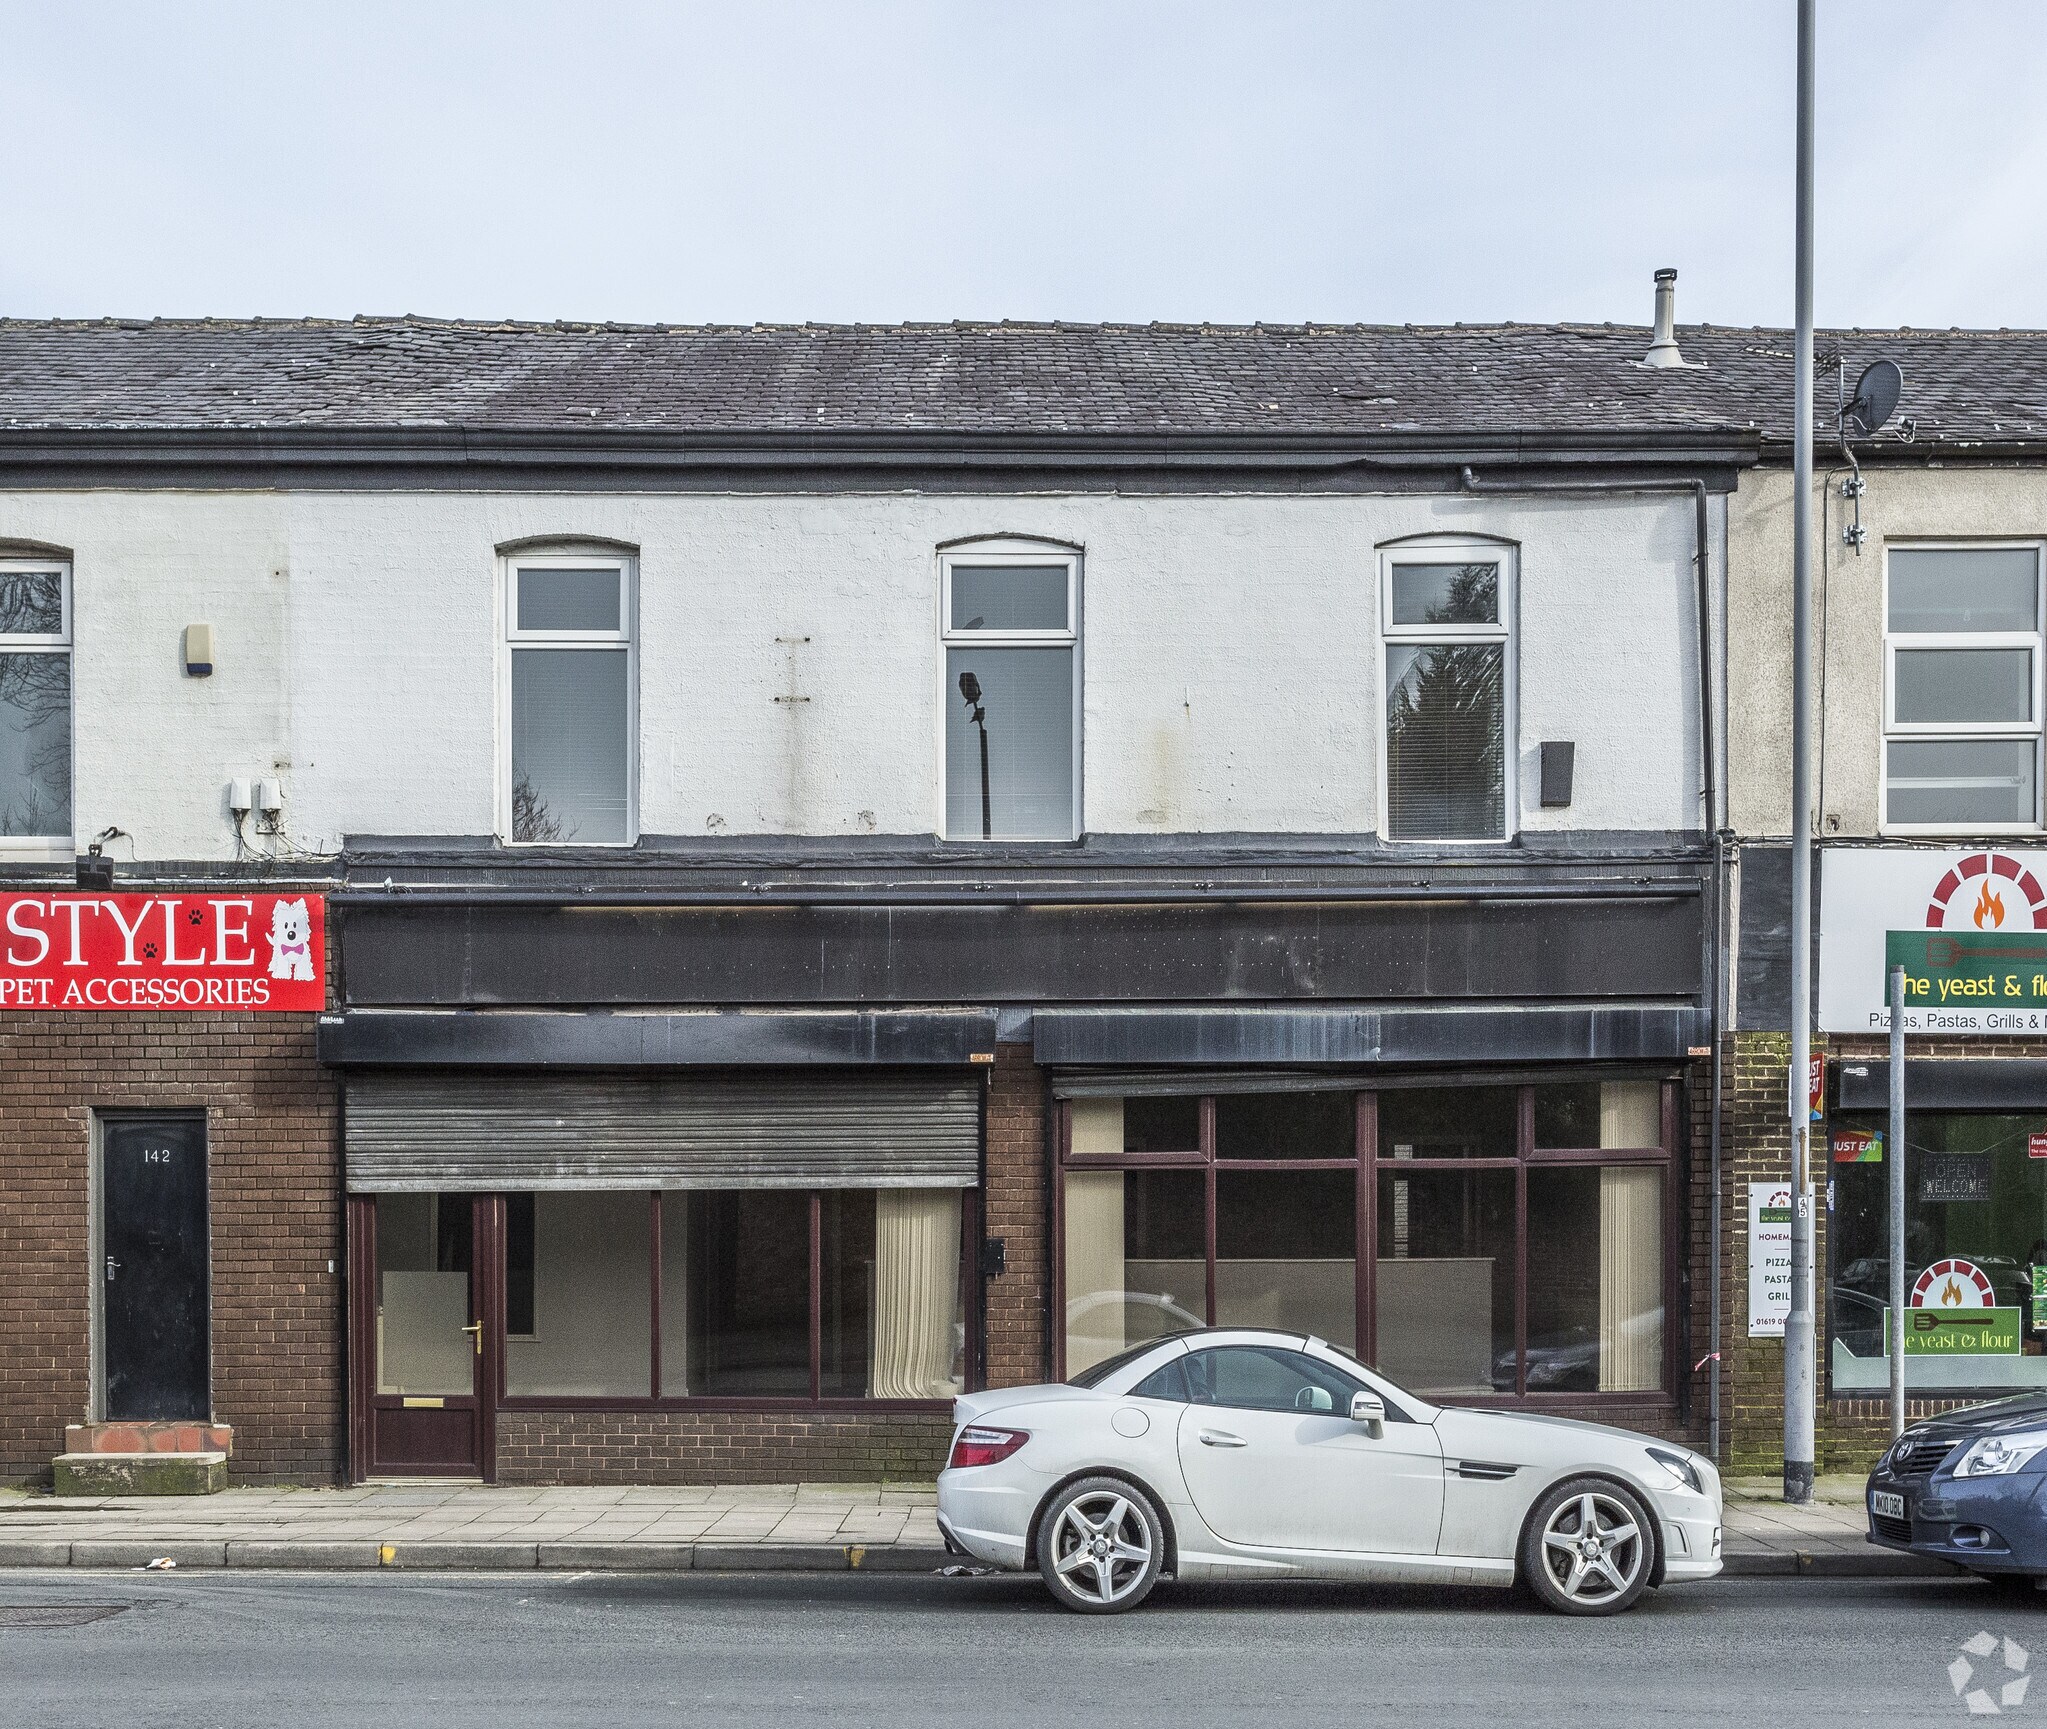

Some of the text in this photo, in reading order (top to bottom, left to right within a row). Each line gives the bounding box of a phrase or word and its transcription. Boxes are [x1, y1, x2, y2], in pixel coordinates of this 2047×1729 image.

[6, 899, 255, 967] STYLE
[0, 978, 270, 1005] PET ACCESSORIES
[1903, 973, 1931, 995] he
[1938, 975, 1996, 1002] yeast
[2004, 975, 2022, 996] &
[1869, 1013, 1922, 1029] Pizas,
[1927, 1013, 1981, 1030] Pastas,
[1986, 1013, 2024, 1029] Grills
[2028, 1014, 2039, 1029] &
[1858, 1141, 1879, 1151] EAT
[143, 1149, 170, 1163] 142
[1935, 1163, 1977, 1178] OPEN
[1926, 1179, 1987, 1193] WELCOME
[1765, 1258, 1791, 1267] PIZZA
[1764, 1275, 1791, 1284] PASTA
[1767, 1292, 1790, 1301] GRIL
[1920, 1333, 1954, 1353] yeast
[1981, 1330, 2013, 1348] flour
